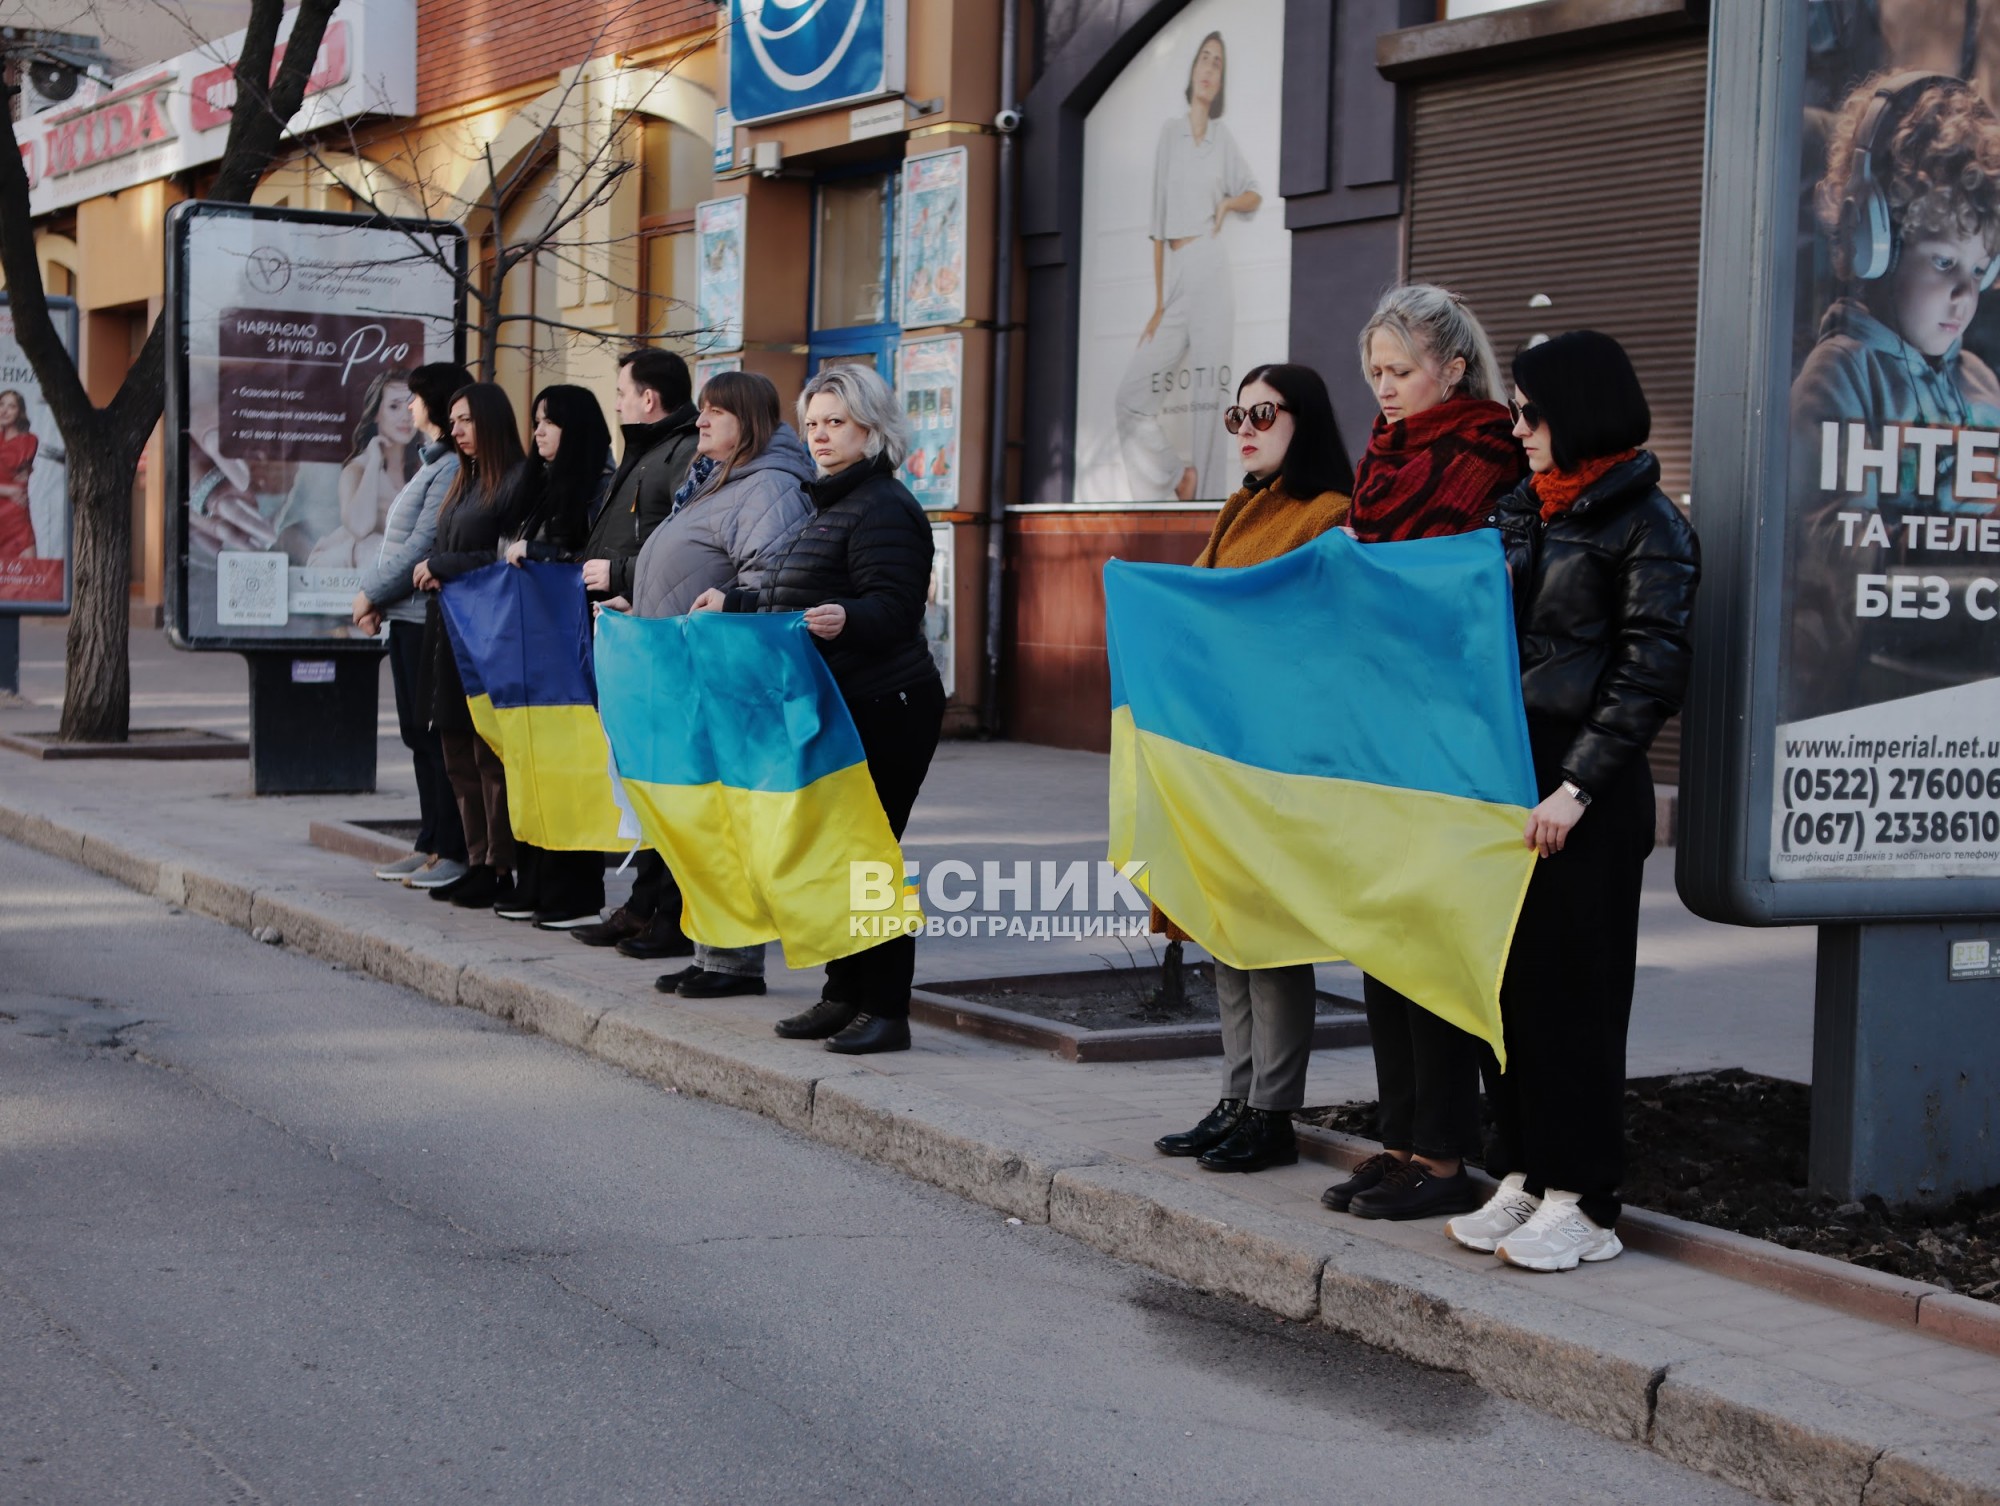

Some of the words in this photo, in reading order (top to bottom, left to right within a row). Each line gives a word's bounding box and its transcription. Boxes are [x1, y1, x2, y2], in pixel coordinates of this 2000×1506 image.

[43, 88, 170, 178] MIDA
[237, 320, 318, 338] НАВЧАЄМО
[278, 340, 313, 355] НУЛЯ
[315, 341, 337, 356] ДО
[340, 324, 410, 387] Pro
[1152, 365, 1232, 394] ESOTIQ
[1820, 421, 2000, 499] ІНТЕ
[1837, 512, 1891, 549] ТА
[1902, 515, 2000, 552] ТЕЛЕ
[320, 576, 339, 588] +38
[1856, 573, 1951, 620] БЕЗ
[1785, 734, 2000, 764] www.imperial.net.u
[1783, 766, 1880, 809] (0522)
[1888, 767, 2000, 800] 276006
[1781, 810, 1865, 853] (067)
[1875, 811, 2000, 844] 2338610
[1777, 851, 1845, 864] (тарифікація
[1846, 850, 1886, 863] дзвінків
[1896, 850, 1951, 861] мобільного
